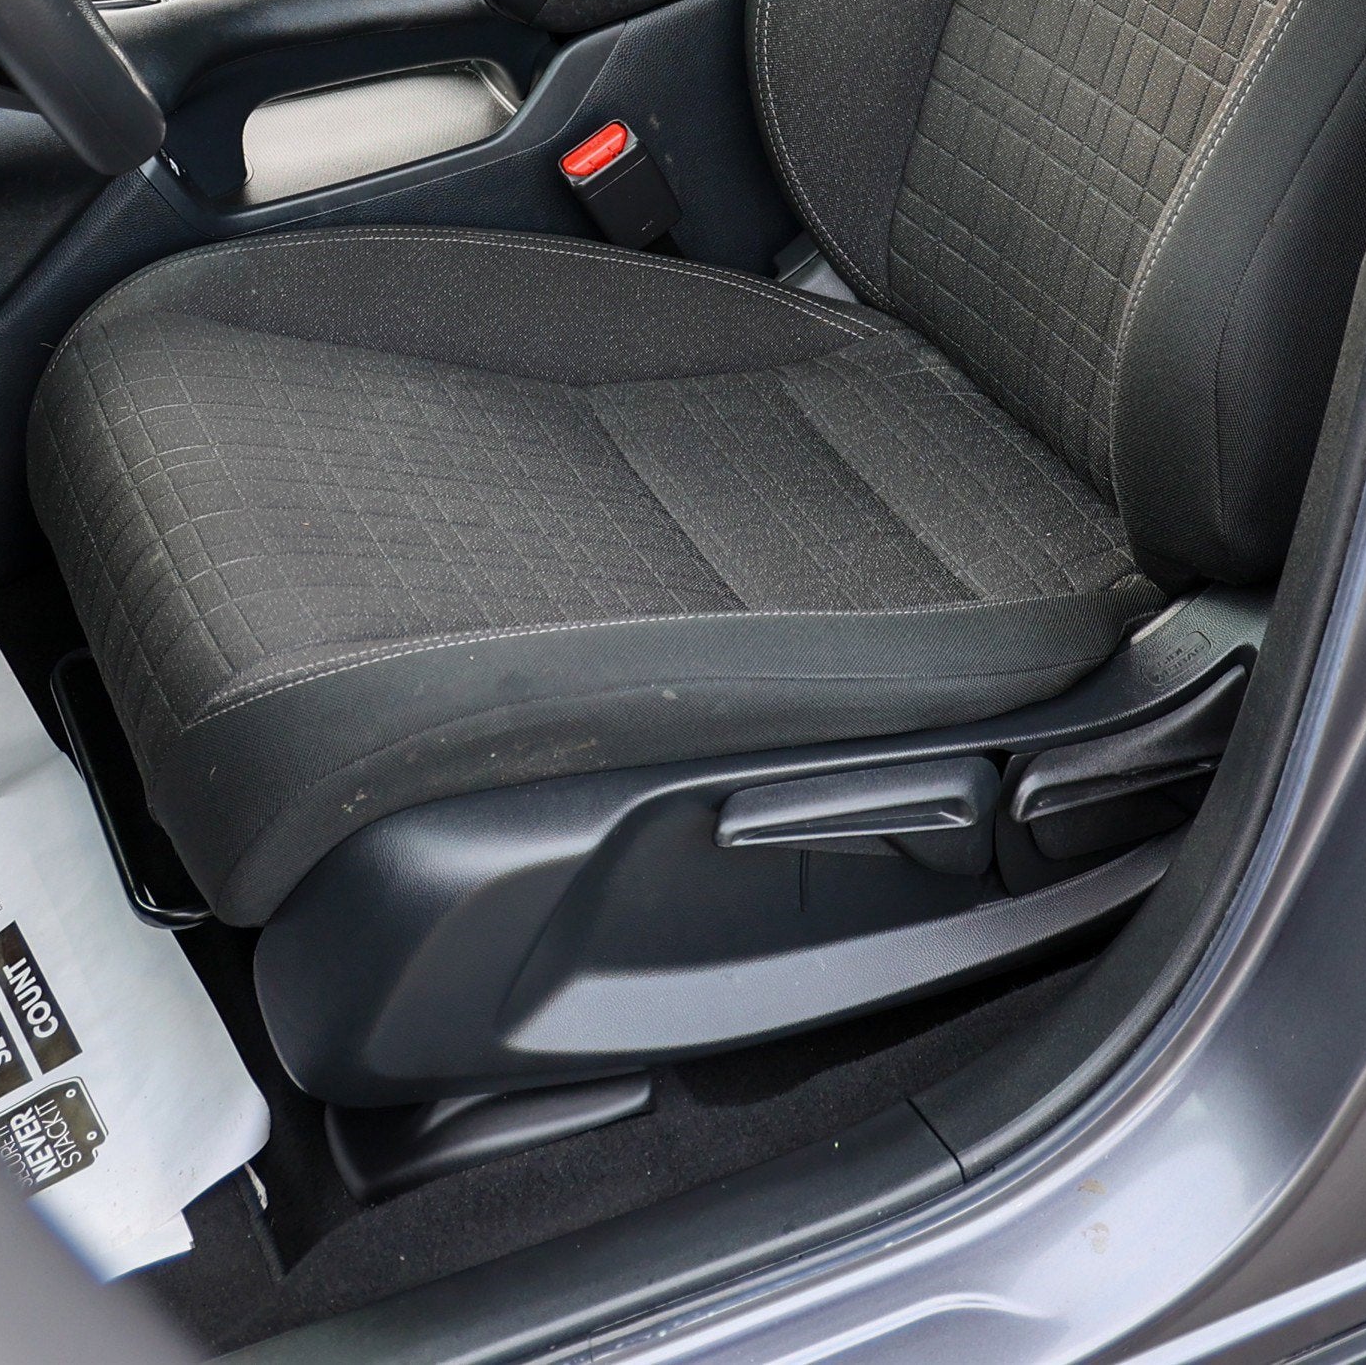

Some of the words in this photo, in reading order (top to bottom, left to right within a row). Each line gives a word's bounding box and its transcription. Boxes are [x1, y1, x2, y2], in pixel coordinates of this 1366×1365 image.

[3, 959, 57, 1037] COUNT
[33, 1098, 57, 1117] IT
[42, 1111, 81, 1168] STACK
[10, 1109, 59, 1181] NEVER
